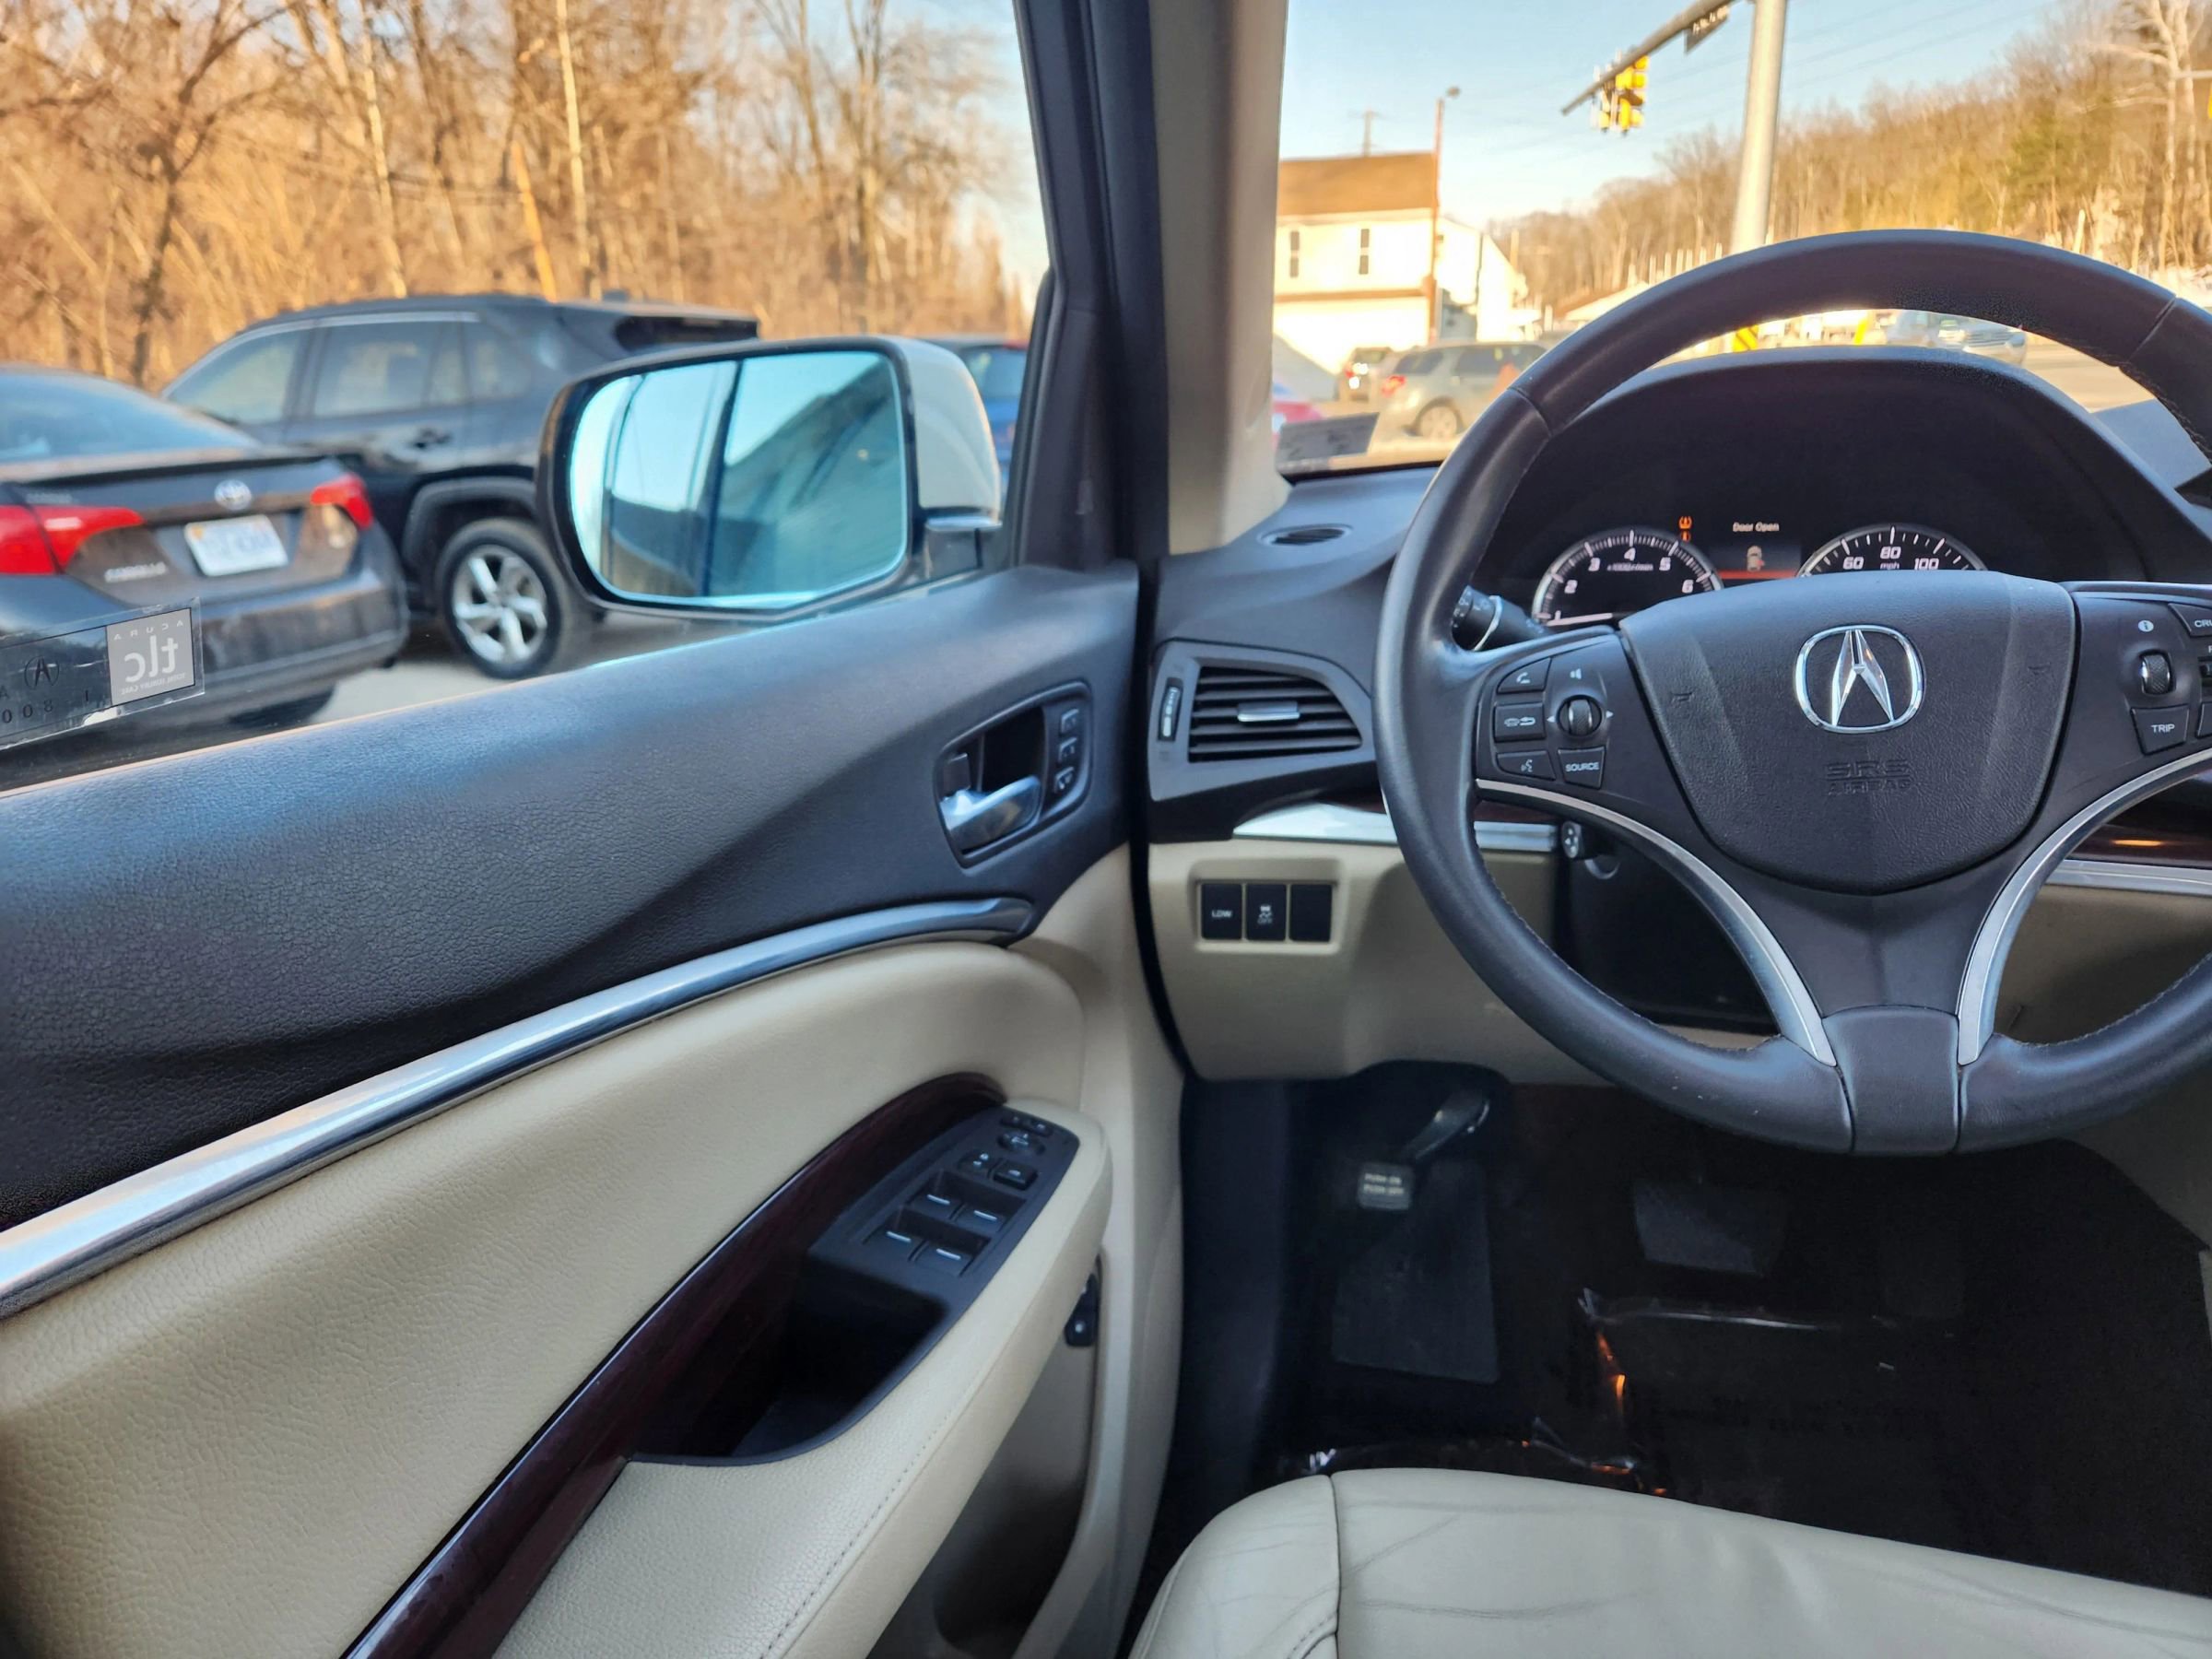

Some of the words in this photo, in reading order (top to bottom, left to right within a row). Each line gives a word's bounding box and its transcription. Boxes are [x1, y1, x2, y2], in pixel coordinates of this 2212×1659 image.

[1733, 522, 1753, 532] Door
[1755, 522, 1780, 533] Open
[1624, 547, 1636, 561] 4
[1880, 546, 1901, 559] 80
[1588, 558, 1601, 571] 3
[1659, 557, 1671, 571] 5
[1843, 557, 1865, 570] 60
[1880, 561, 1900, 571] mph
[1914, 558, 1939, 571] 100
[1564, 580, 1578, 594] 2
[1682, 579, 1694, 594] 6
[2150, 724, 2175, 734] TRIP
[1565, 761, 1600, 772] SOURCE
[1827, 759, 1911, 777] SRS
